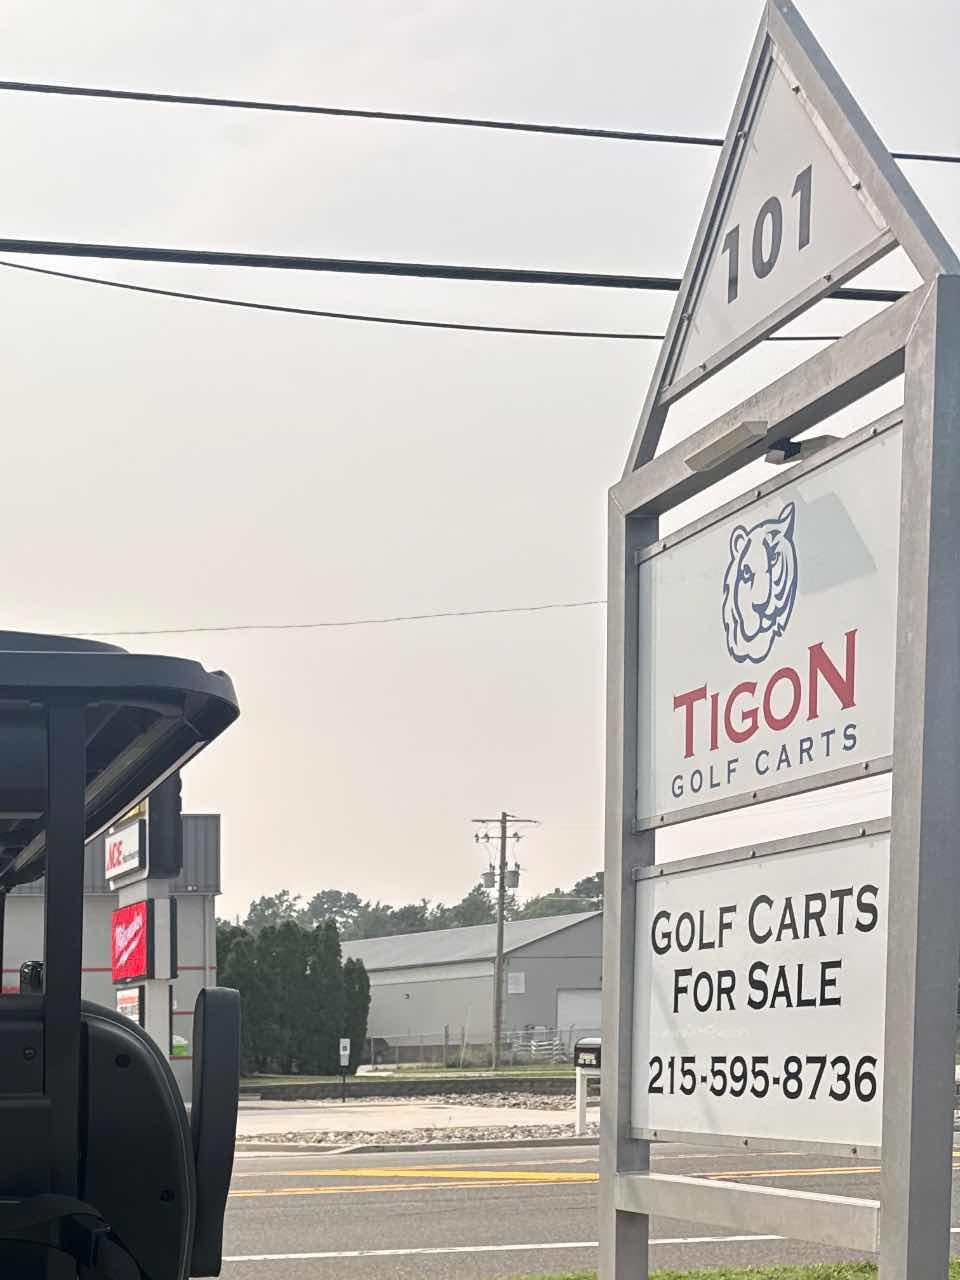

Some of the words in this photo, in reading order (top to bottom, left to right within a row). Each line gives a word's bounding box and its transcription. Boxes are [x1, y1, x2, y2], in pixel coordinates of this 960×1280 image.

[721, 163, 812, 304] 101
[673, 628, 858, 759] TIGON
[671, 757, 739, 799] GOLF
[754, 723, 857, 776] CARTS
[651, 904, 737, 955] GOLF
[748, 884, 880, 945] CARTS
[672, 967, 737, 1013] FOR
[747, 959, 842, 1010] SALE
[647, 1054, 878, 1103] 215-595-8736
